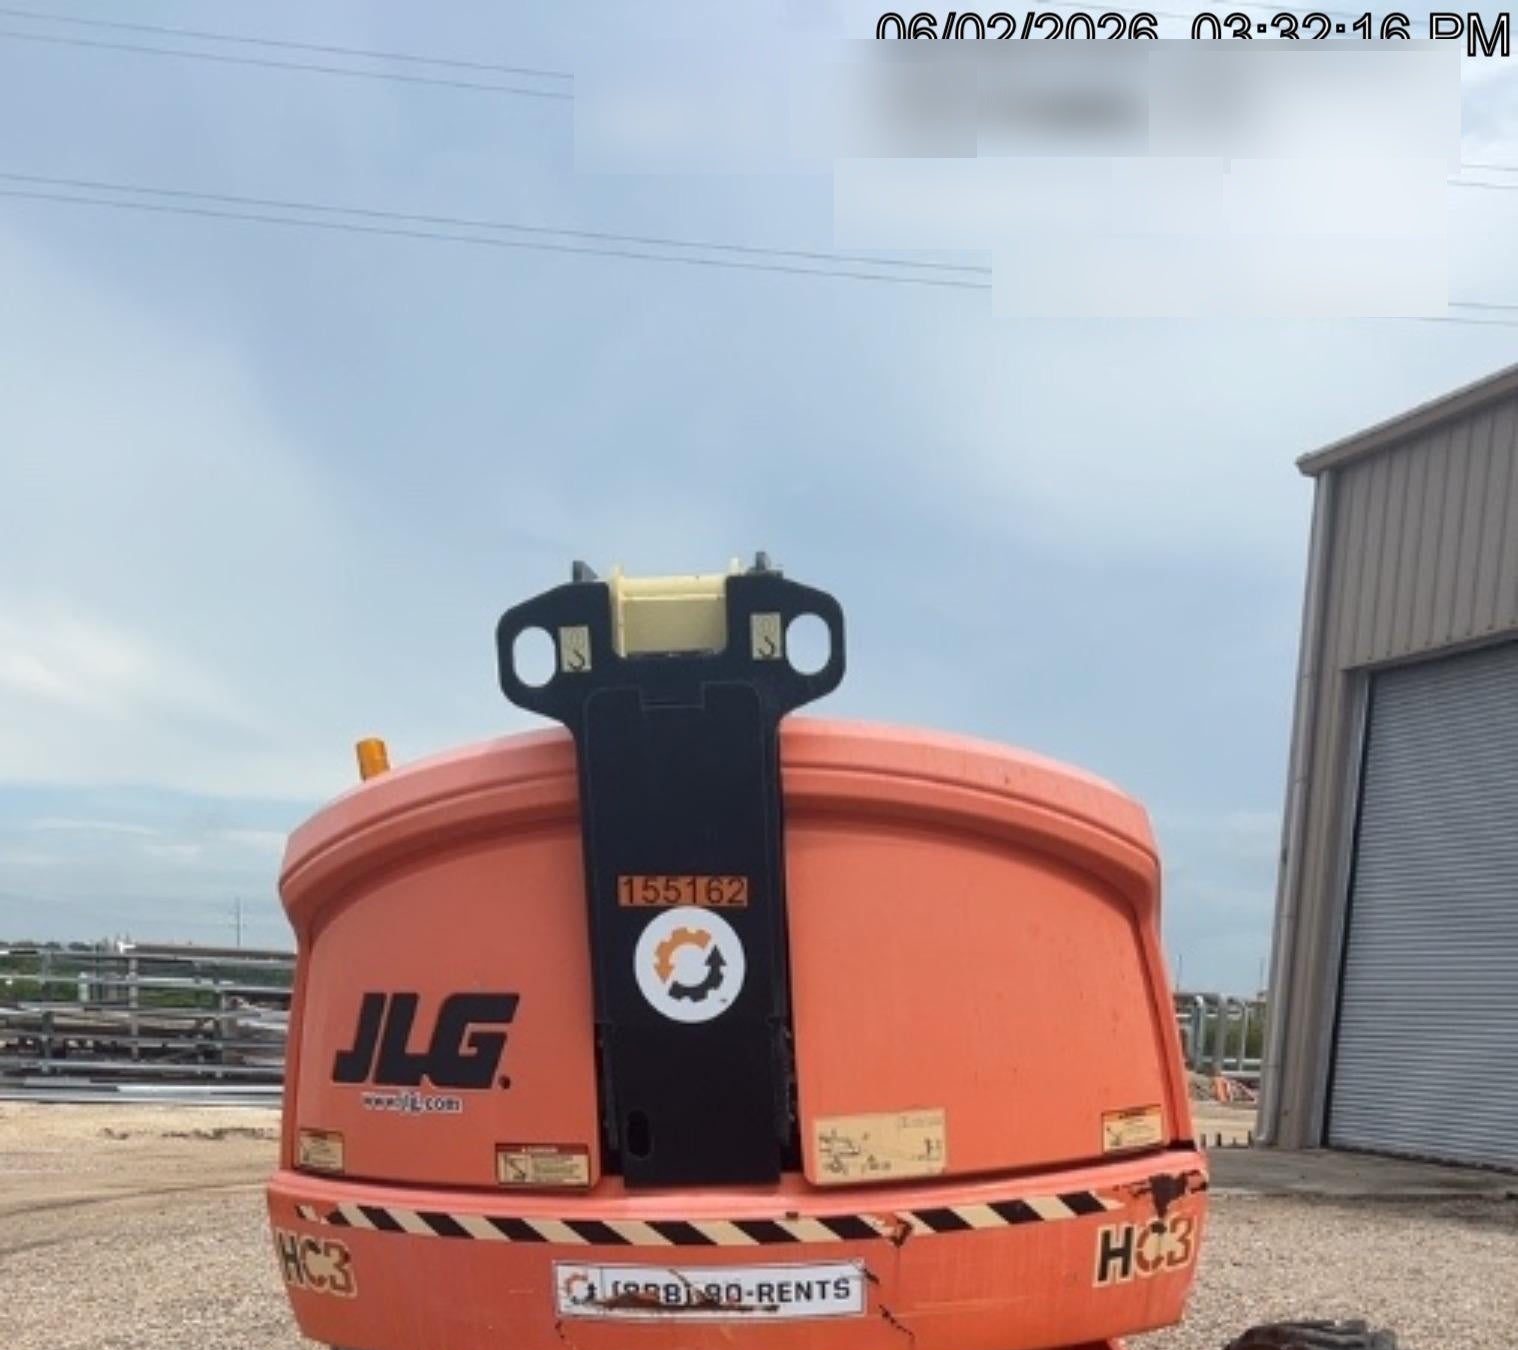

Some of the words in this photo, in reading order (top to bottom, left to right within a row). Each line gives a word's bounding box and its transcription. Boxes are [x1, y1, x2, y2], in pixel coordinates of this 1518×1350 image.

[623, 877, 746, 905] 155162
[278, 1231, 354, 1294] HC3
[1098, 1218, 1192, 1282] HC3
